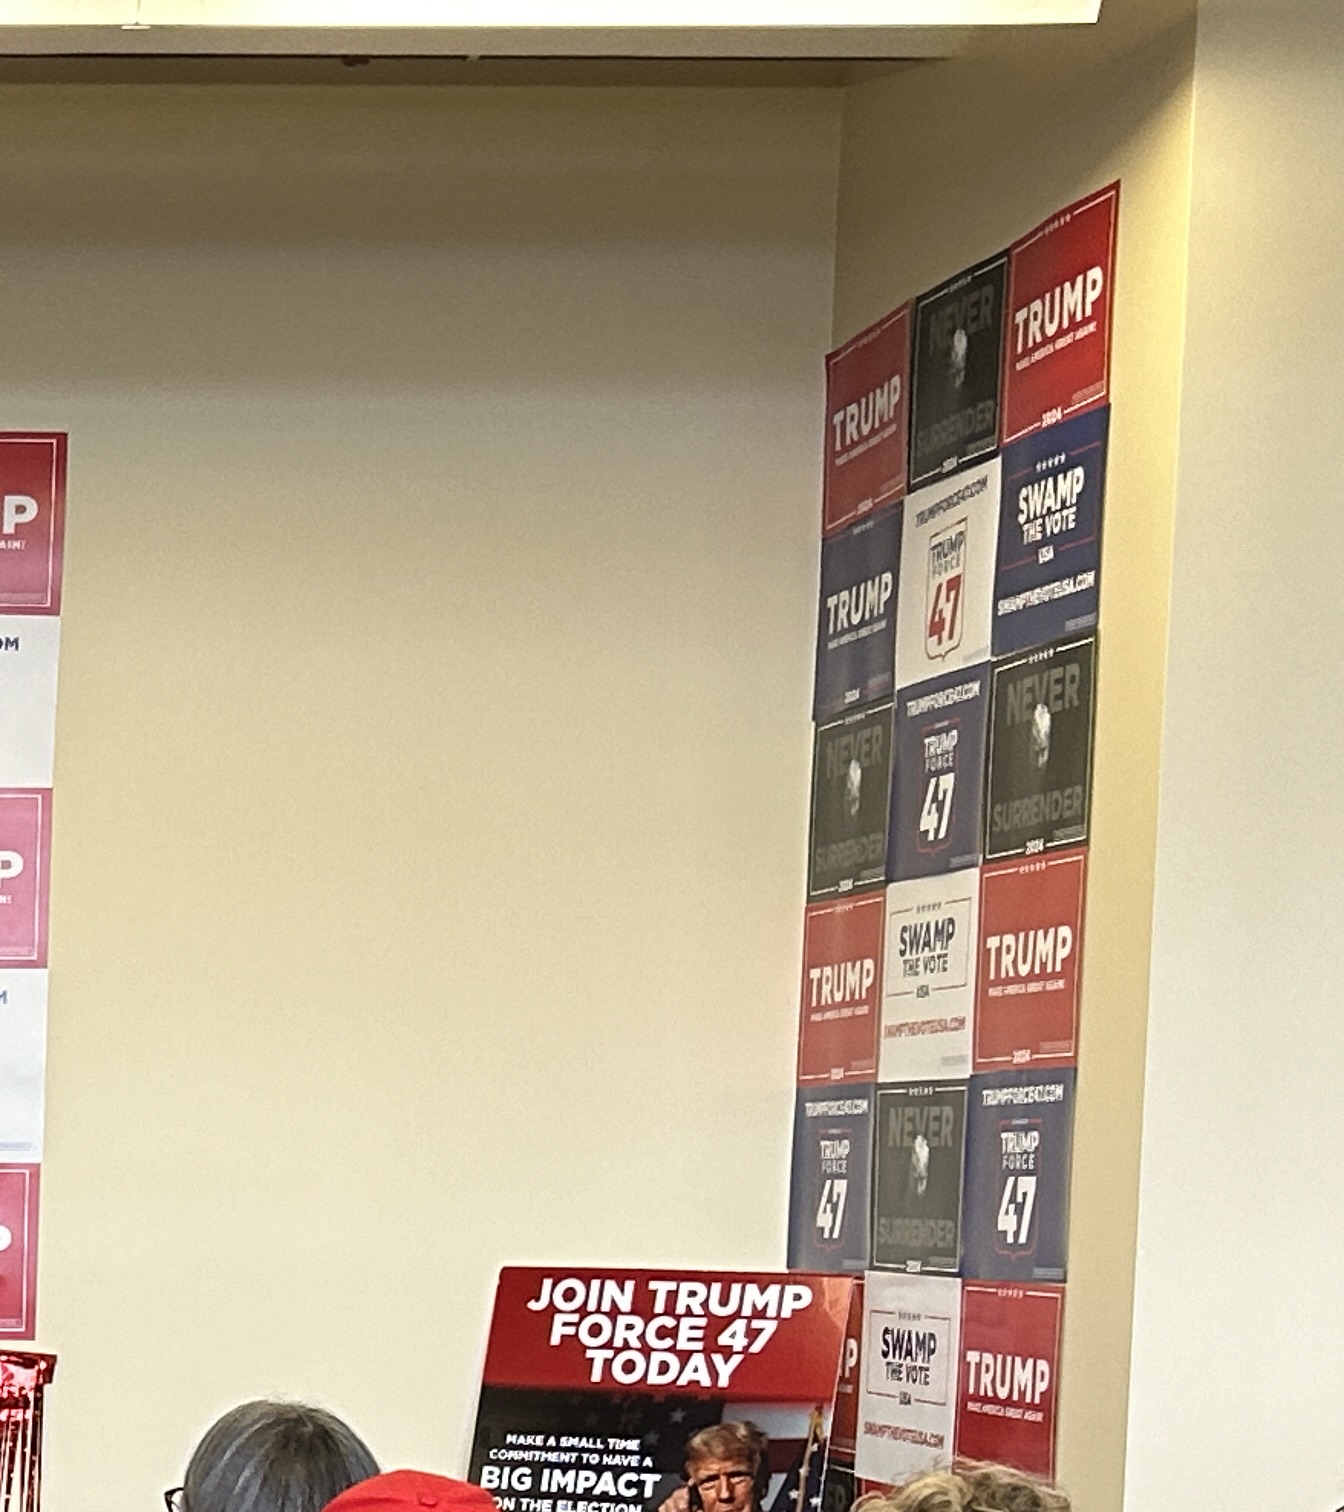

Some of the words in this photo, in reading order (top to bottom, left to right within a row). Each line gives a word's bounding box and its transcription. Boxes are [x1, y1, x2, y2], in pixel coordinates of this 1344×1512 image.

[1015, 266, 1104, 354] TRUMP
[832, 374, 901, 452] TRUMP
[1018, 466, 1085, 524] SWAMP
[1023, 520, 1044, 545] THE
[1045, 509, 1077, 538] VOTE
[826, 571, 893, 636] TRUMP
[928, 574, 962, 646] 47
[1006, 663, 1080, 726] NEVER
[924, 729, 958, 758] TRUMP
[919, 773, 955, 842] 47
[992, 786, 1083, 834] SURRENDER
[899, 917, 956, 957] SWAMP
[986, 926, 1072, 981] TRUMP
[810, 958, 874, 1008] TRUMP
[903, 956, 920, 978] THE
[923, 954, 948, 974] VOTE
[888, 1106, 954, 1148] NEVER
[1000, 1131, 1040, 1155] TRUMP
[1002, 1154, 1035, 1170] FORCE
[816, 1179, 848, 1239] 47
[997, 1176, 1037, 1244] 47
[527, 1278, 635, 1313] JOIN
[648, 1281, 812, 1318] TRUMP
[550, 1313, 708, 1351] FORCE
[717, 1319, 778, 1353] 47
[881, 1327, 937, 1364] SWAMP
[585, 1350, 745, 1388] TODAY
[885, 1362, 903, 1382] THE
[905, 1365, 930, 1386] VOTE
[966, 1351, 1049, 1404] TRUMP
[489, 1449, 579, 1464] COMMITMENT
[582, 1453, 600, 1465] TO
[602, 1454, 641, 1467] HAVE
[642, 1456, 653, 1468] A
[506, 1433, 545, 1446] MAKE
[546, 1436, 557, 1447] A
[559, 1436, 604, 1449] SMALL
[607, 1438, 641, 1451] TIME
[480, 1466, 532, 1491] BIG
[540, 1469, 662, 1498] IMPACT
